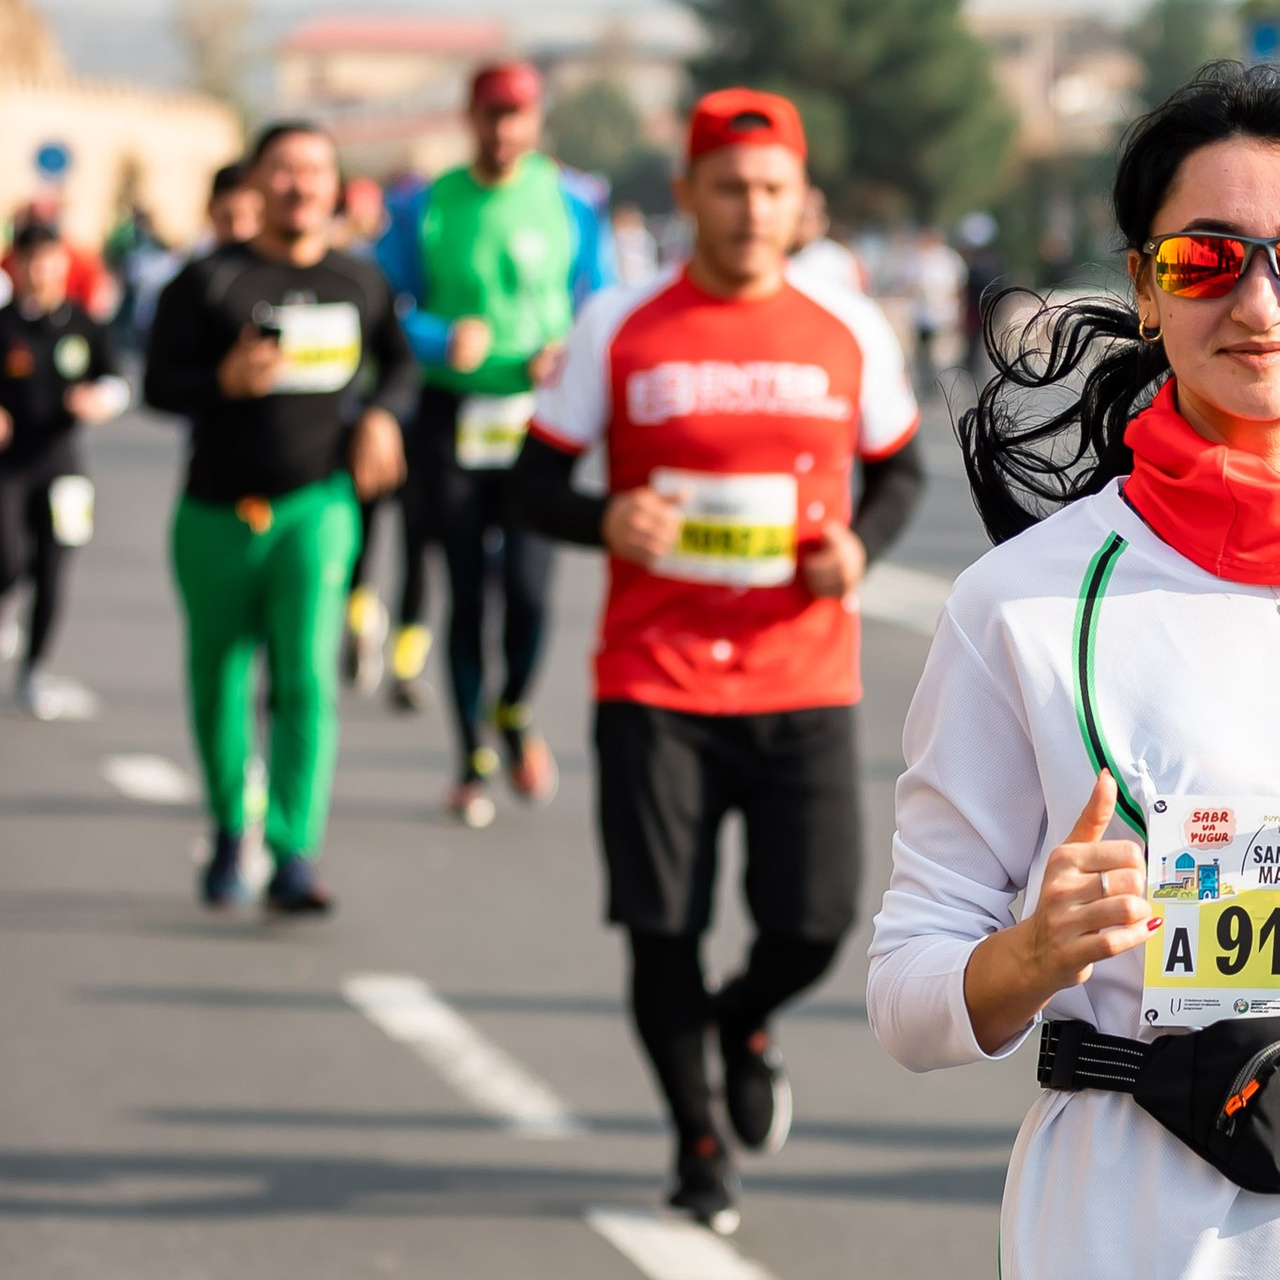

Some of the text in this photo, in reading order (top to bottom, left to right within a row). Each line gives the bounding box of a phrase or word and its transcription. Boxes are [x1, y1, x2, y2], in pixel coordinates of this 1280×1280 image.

[1191, 811, 1230, 823] SABR
[1190, 832, 1229, 843] YUGUR
[1165, 927, 1194, 972] A
